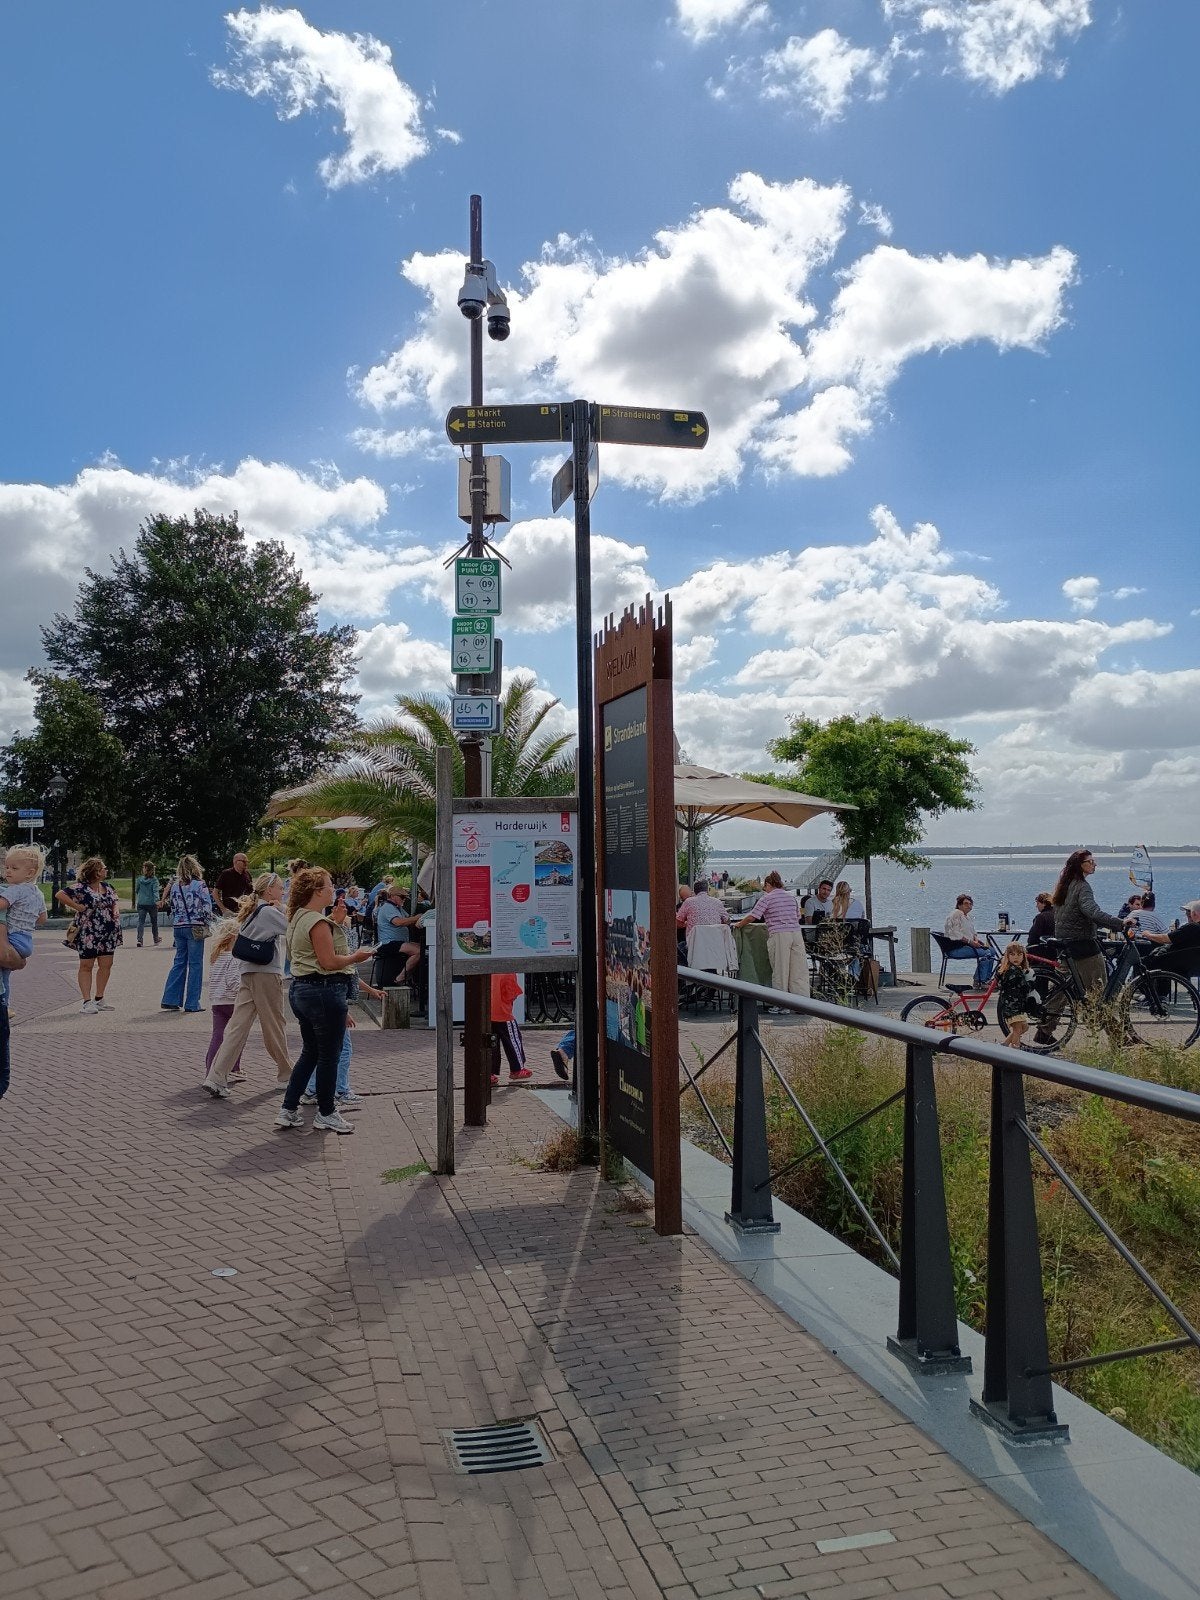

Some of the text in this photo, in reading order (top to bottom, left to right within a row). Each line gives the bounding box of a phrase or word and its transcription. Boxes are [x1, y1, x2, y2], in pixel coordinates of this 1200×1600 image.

[477, 408, 501, 418] Markt
[612, 410, 661, 420] Strandeiland
[477, 420, 506, 428] Station
[482, 564, 493, 572] 82
[481, 580, 493, 588] 09
[465, 597, 474, 605] 11
[475, 622, 486, 630] 82
[475, 638, 485, 646] 09
[459, 655, 468, 663] 16
[606, 646, 637, 680] WELKOM
[613, 716, 647, 744] Strandeiland
[495, 821, 548, 833] Harderwijk
